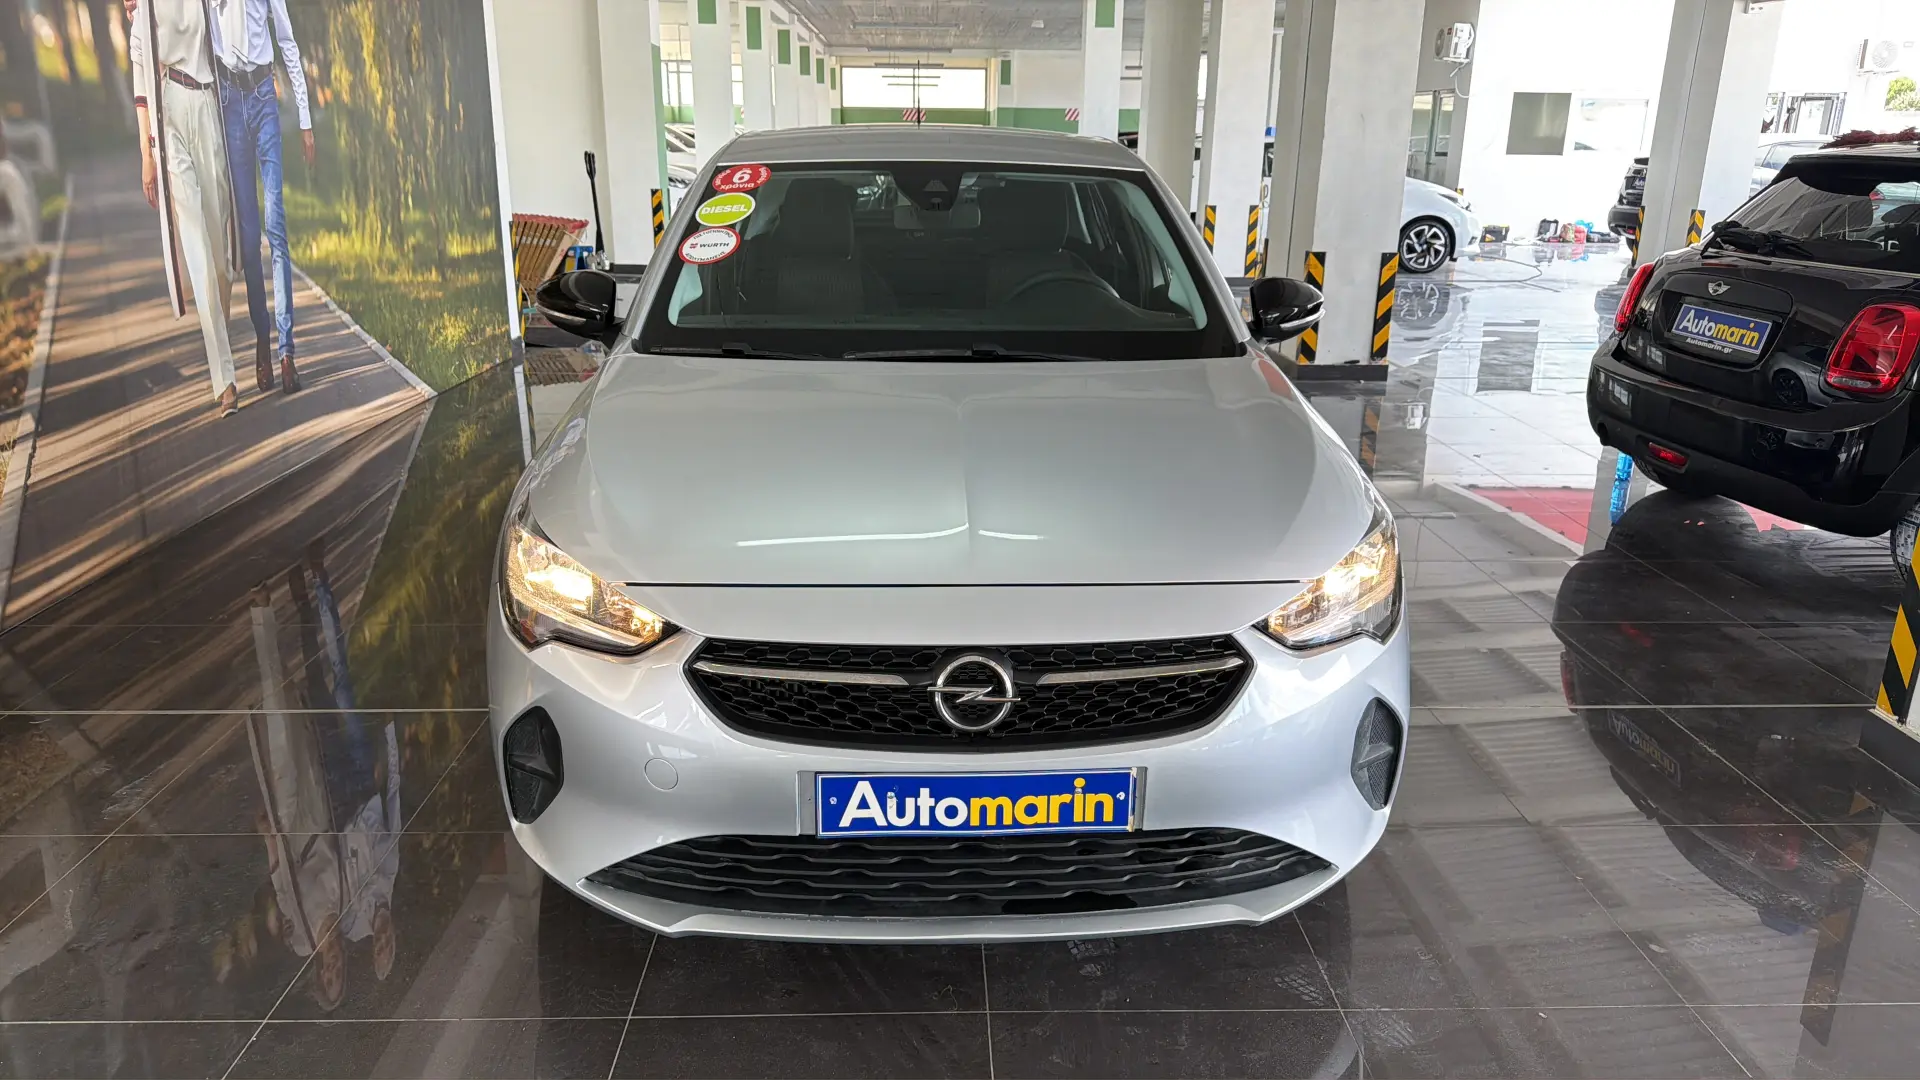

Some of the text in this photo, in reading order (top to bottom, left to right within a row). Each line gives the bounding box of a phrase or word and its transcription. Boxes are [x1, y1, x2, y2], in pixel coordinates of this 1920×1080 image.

[732, 169, 752, 183] 6
[701, 204, 748, 215] DIESEL
[1679, 309, 1759, 347] Automarin
[1685, 337, 1733, 354] Automarin.gr
[838, 777, 1114, 828] Automarin
